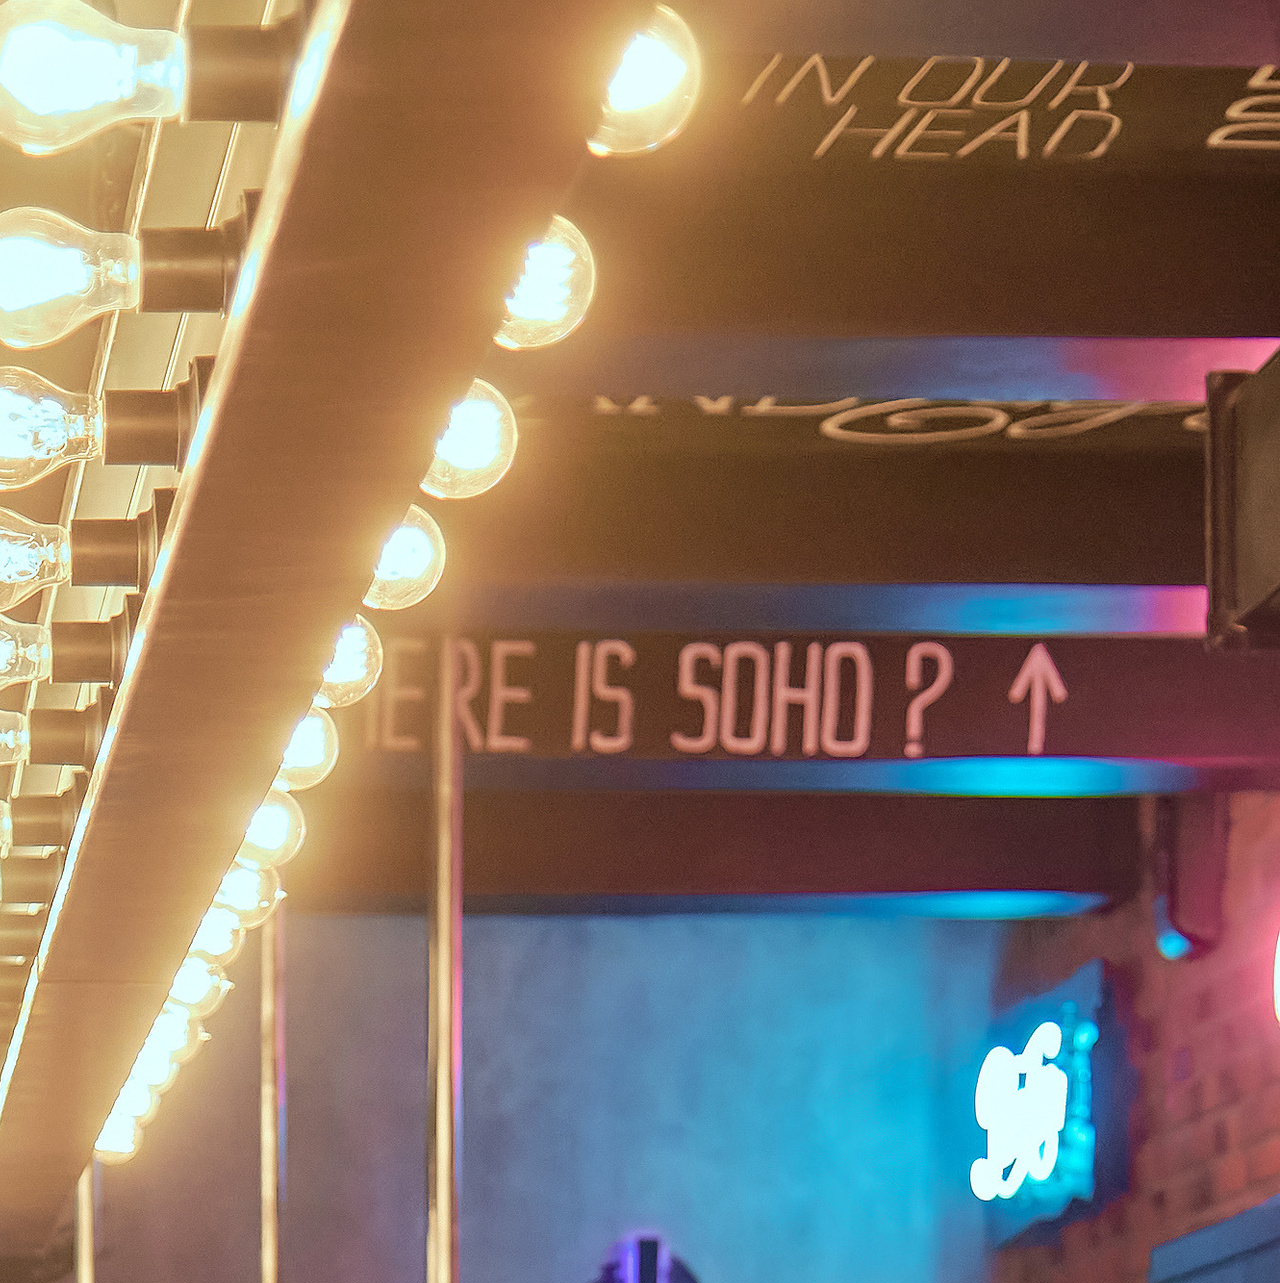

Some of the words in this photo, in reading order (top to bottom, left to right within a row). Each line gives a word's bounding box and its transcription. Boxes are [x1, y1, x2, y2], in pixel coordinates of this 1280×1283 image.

[740, 51, 875, 106] IN
[813, 103, 1122, 160] HEAD
[571, 638, 637, 754] IS
[670, 640, 874, 758] SOHO
